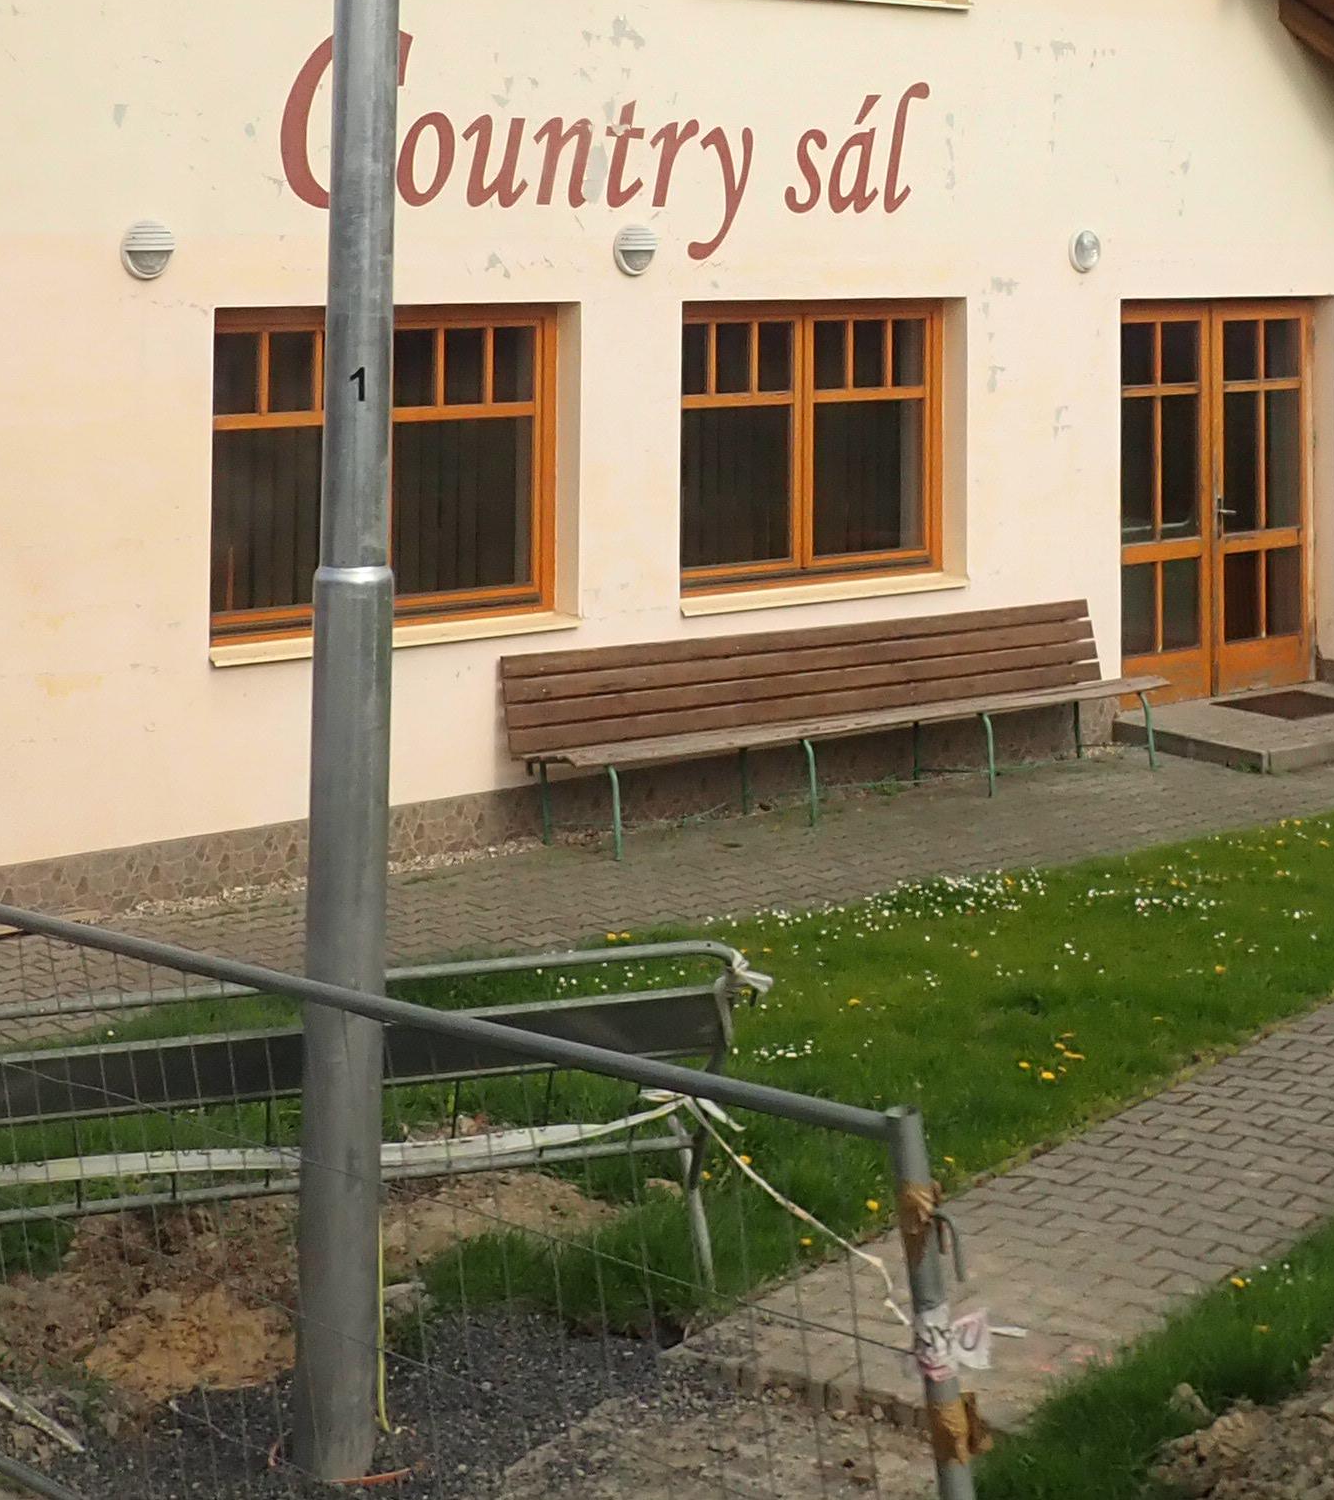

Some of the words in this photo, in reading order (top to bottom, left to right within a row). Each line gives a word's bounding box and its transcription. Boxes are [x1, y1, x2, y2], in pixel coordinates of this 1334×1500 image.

[279, 29, 754, 261] Country
[783, 81, 931, 214] sál
[349, 366, 367, 402] 1
